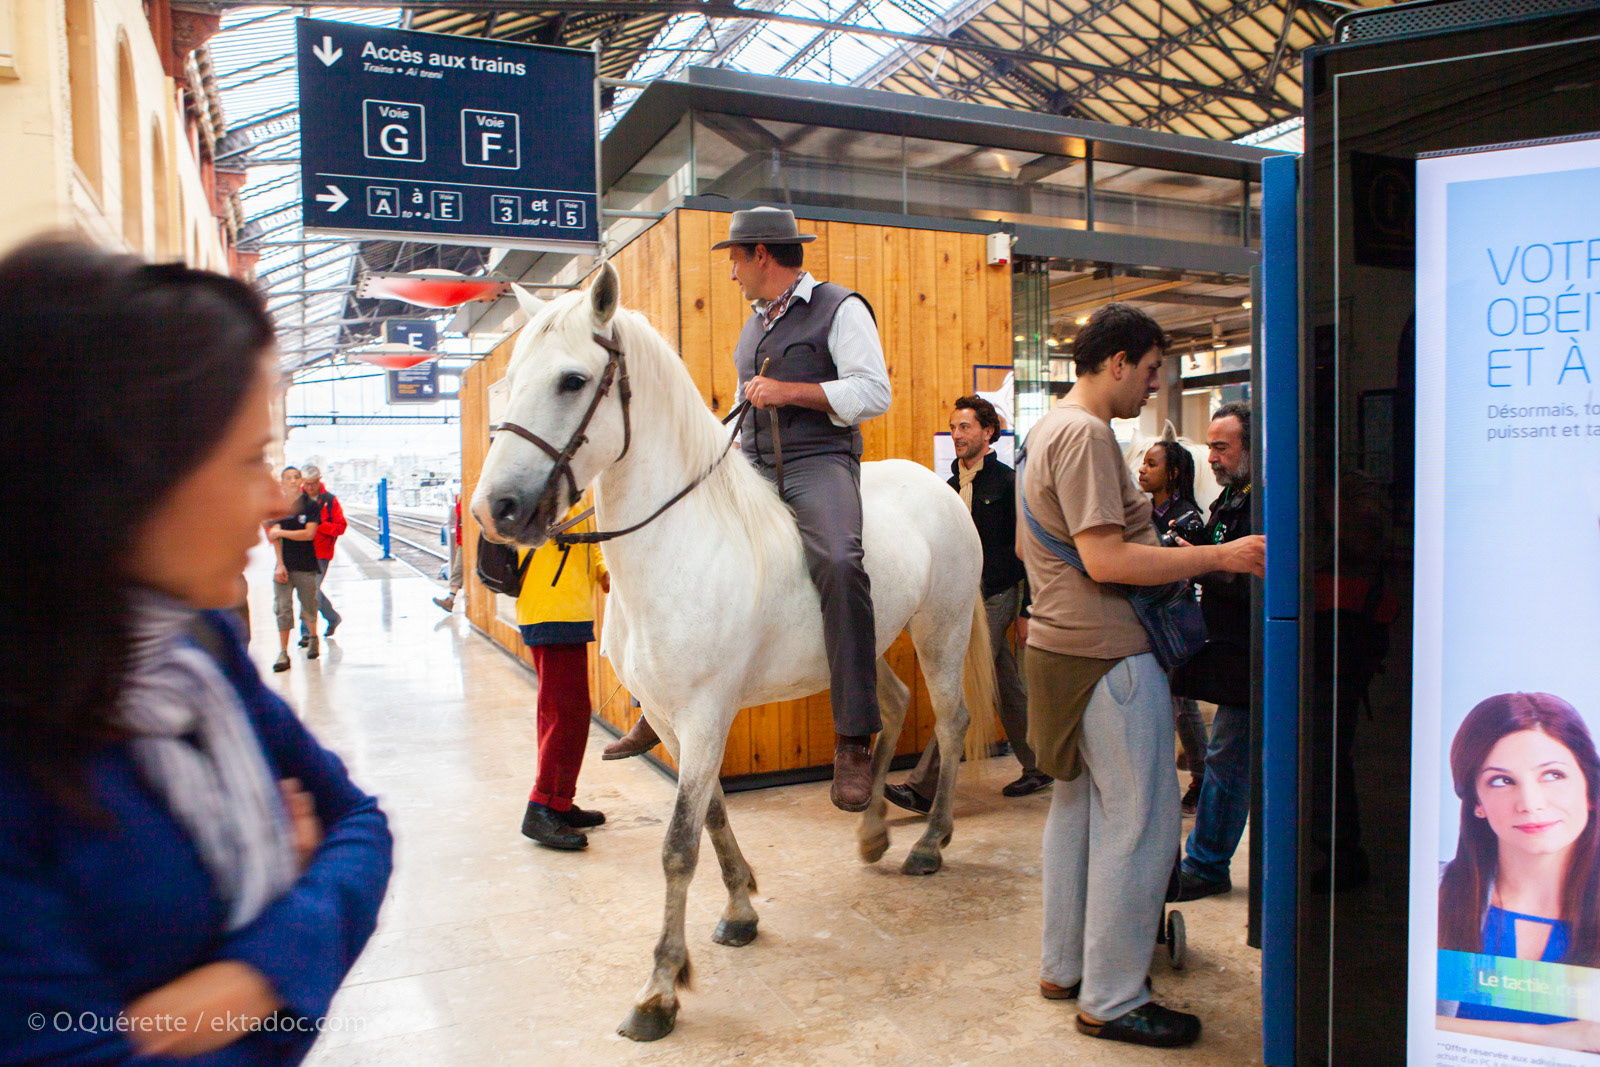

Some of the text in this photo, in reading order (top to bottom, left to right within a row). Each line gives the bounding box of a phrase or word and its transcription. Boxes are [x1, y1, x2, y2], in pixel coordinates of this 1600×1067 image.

[361, 41, 527, 76] Accès aux trains
[362, 62, 395, 75] Trains
[379, 105, 410, 119] Voie
[476, 115, 505, 128] Voie
[380, 124, 409, 155] G
[482, 132, 502, 161] F
[375, 187, 453, 218] A à E
[501, 199, 577, 226] 3 et 5
[1487, 284, 1600, 337] OBÉI
[1488, 337, 1591, 387] ET À
[1487, 402, 1578, 419] Désormais,
[1487, 424, 1557, 442] puissant
[1562, 424, 1580, 437] et
[1479, 971, 1499, 987] Le
